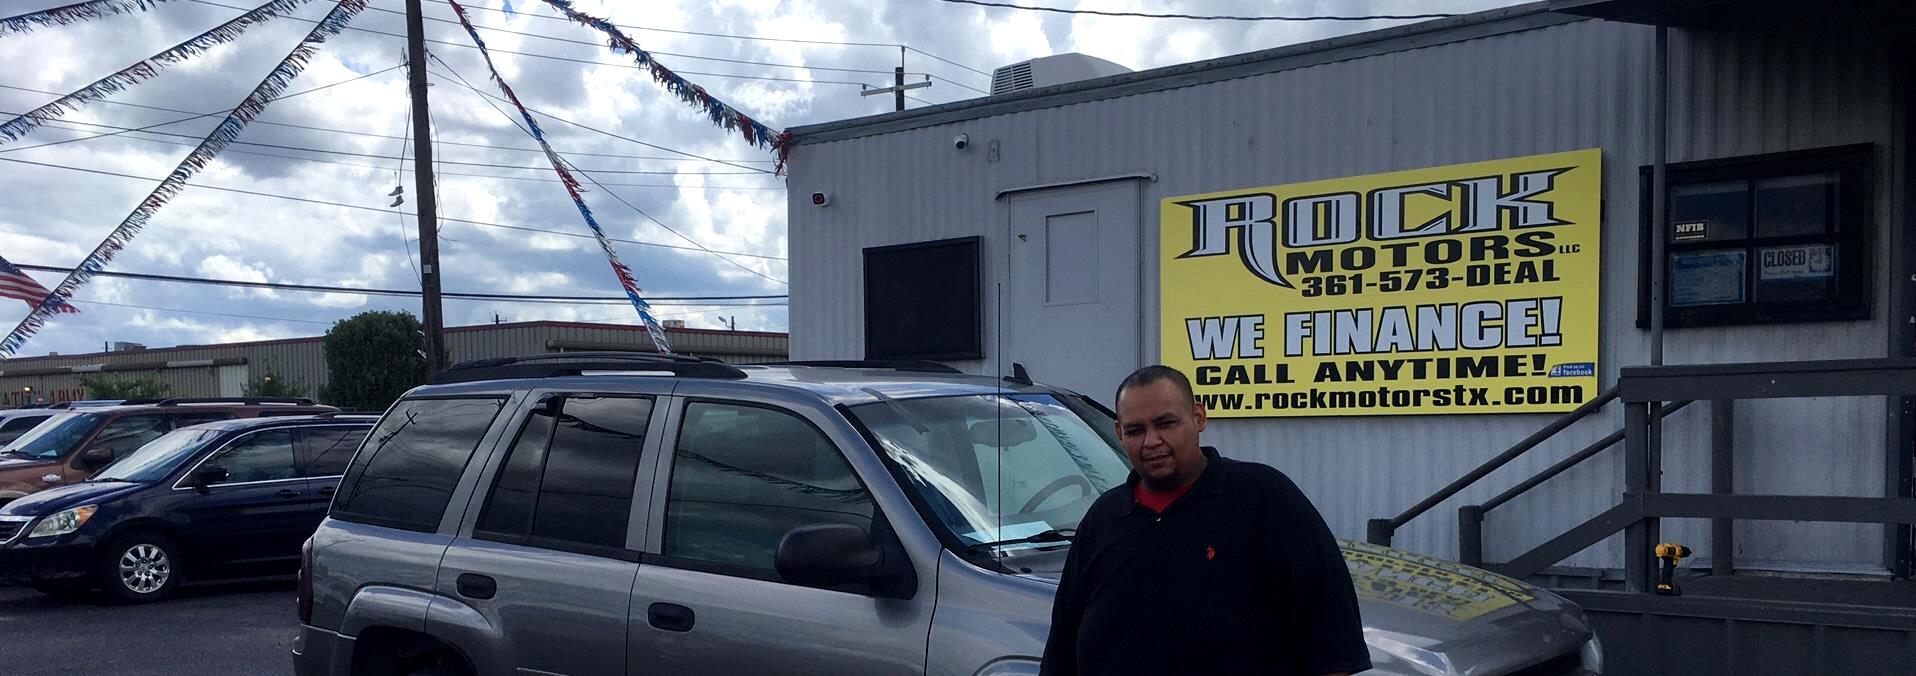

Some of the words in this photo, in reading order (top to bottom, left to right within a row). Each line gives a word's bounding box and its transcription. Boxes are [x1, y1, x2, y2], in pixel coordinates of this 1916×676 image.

[1172, 165, 1580, 290] ROCK
[1676, 222, 1705, 233] NFIB
[1286, 231, 1556, 275] MOTORS
[1559, 243, 1581, 254] LLC
[1763, 249, 1806, 268] CLOSED
[1301, 259, 1560, 298] 361-573-DEAL
[1185, 313, 1265, 360] WE
[1284, 296, 1563, 358] FINANCE!
[1195, 363, 1295, 386] CALL
[1313, 354, 1547, 383] ANYTIME!
[1194, 382, 1584, 411] ww.rockmotorstx.com
